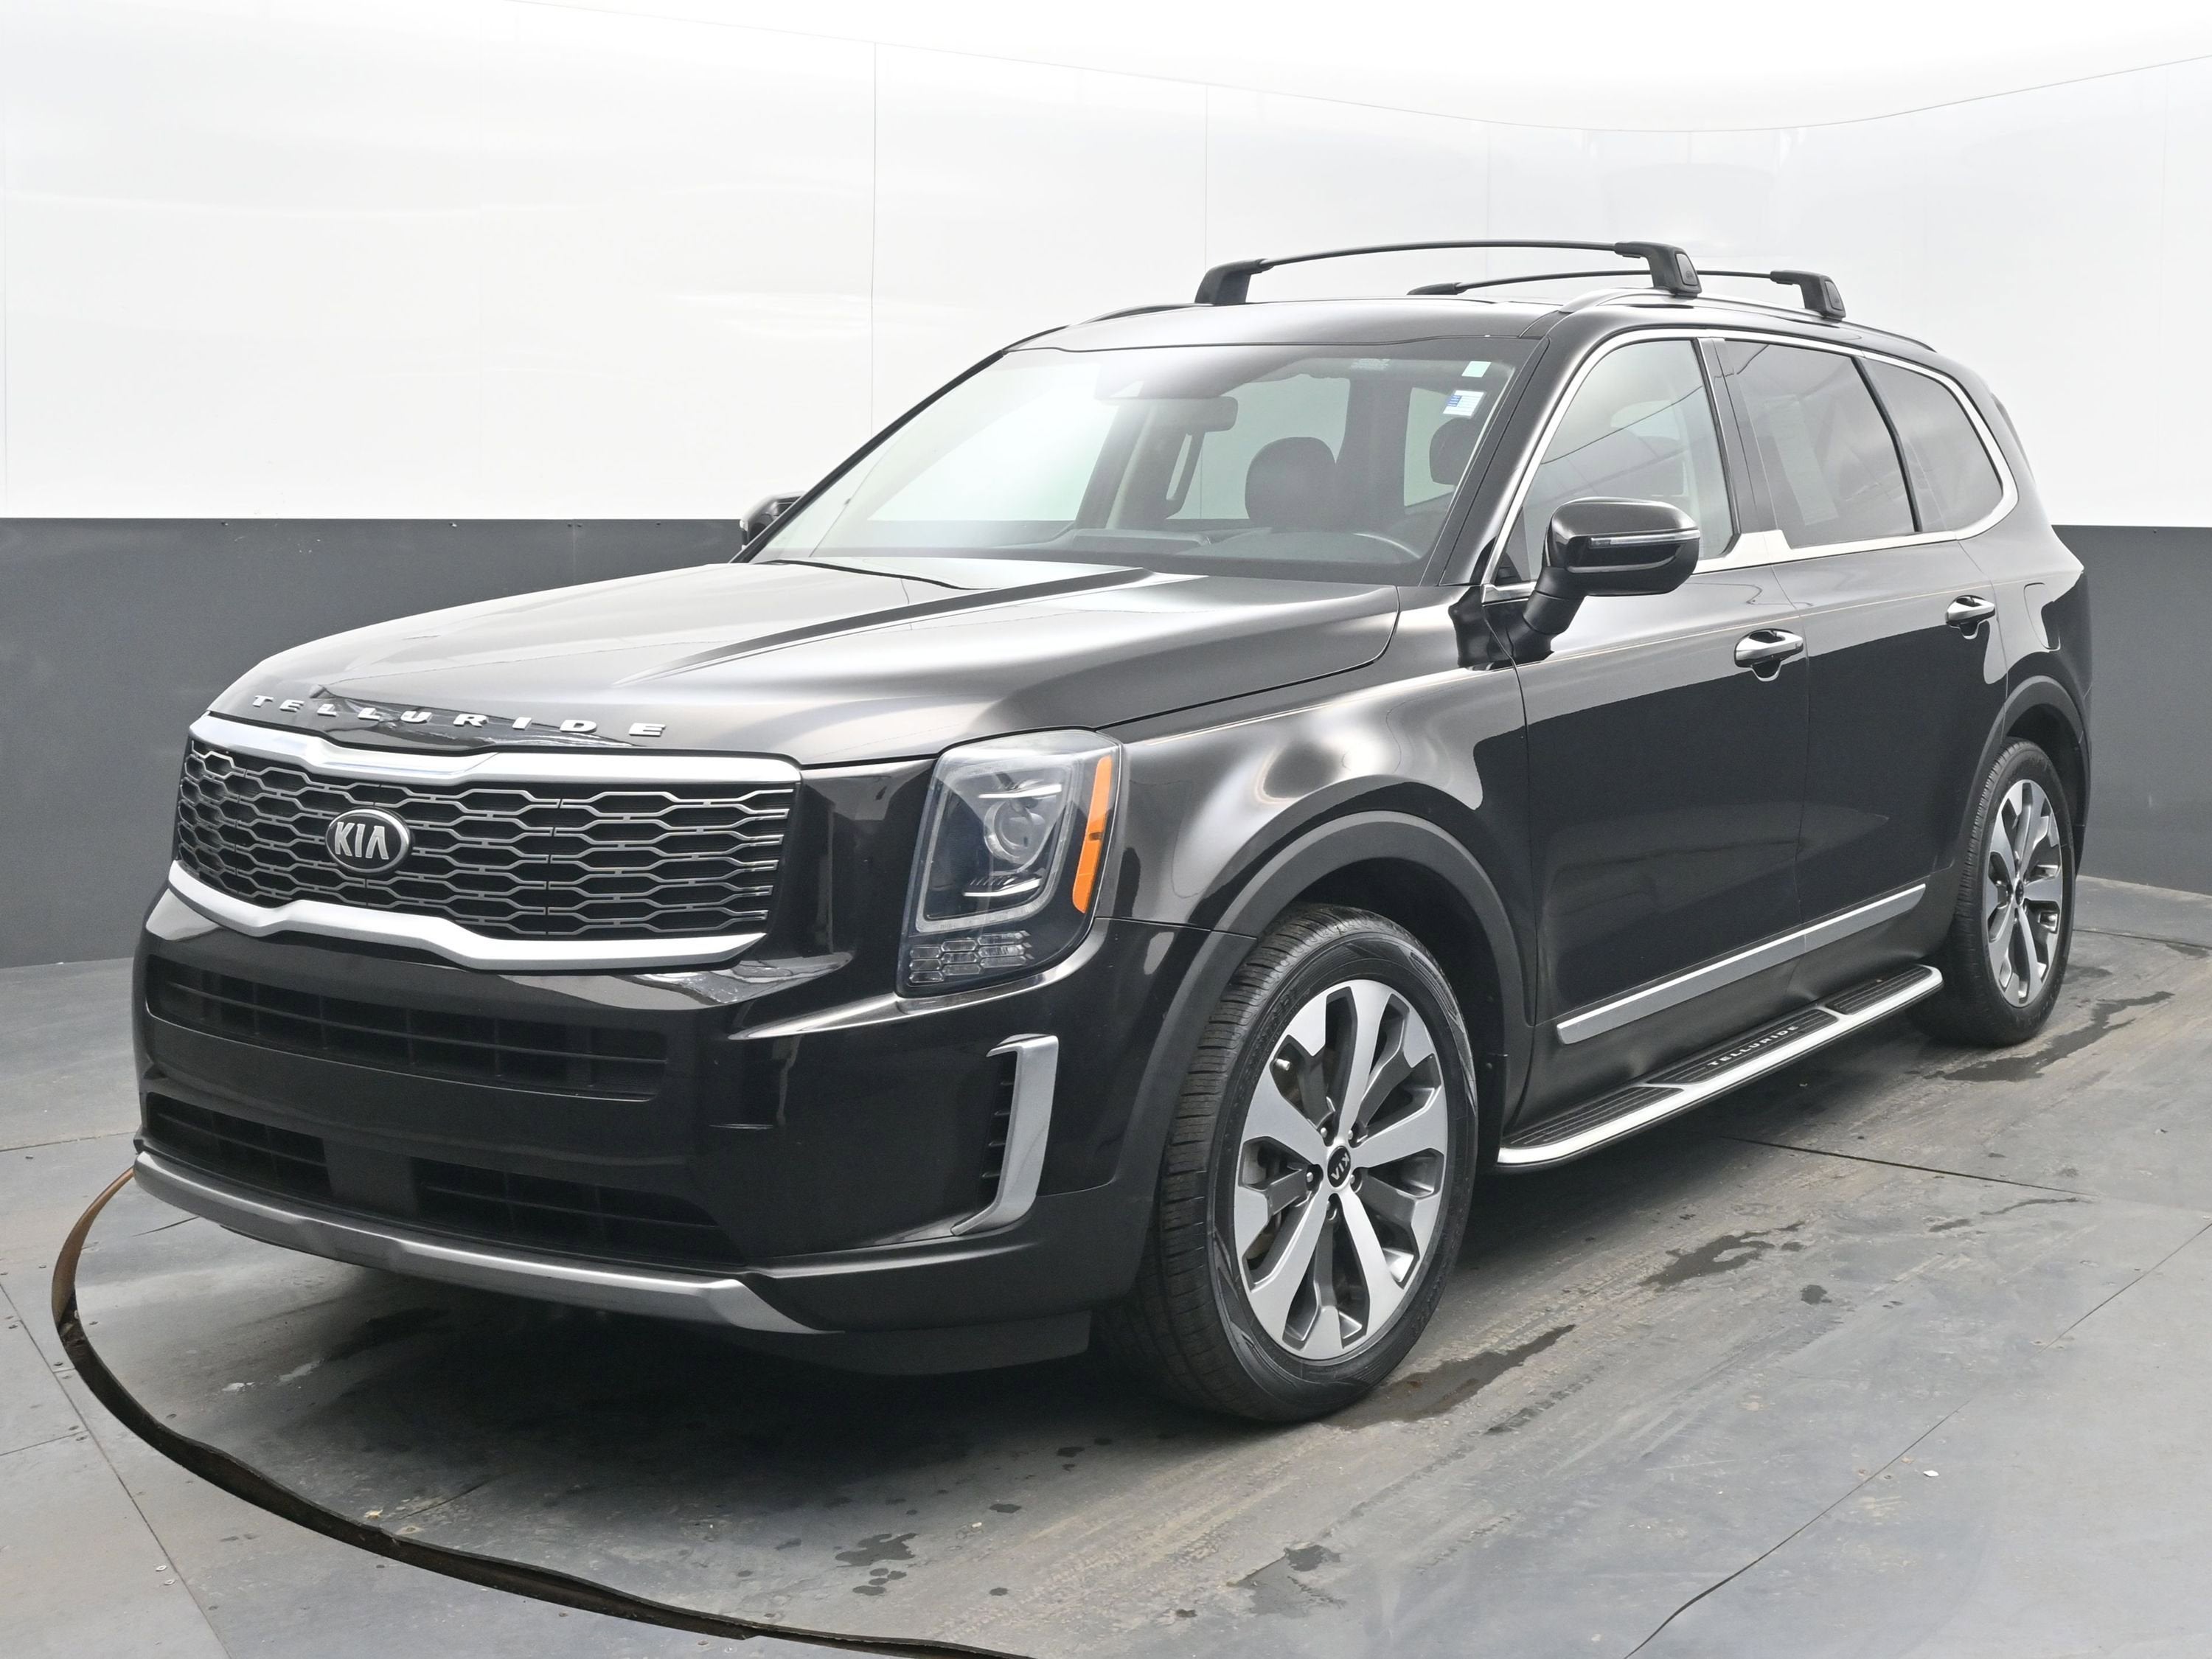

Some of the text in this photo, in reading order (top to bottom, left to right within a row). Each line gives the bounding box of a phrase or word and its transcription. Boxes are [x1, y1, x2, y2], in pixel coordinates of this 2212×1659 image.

[251, 695, 667, 737] TELLURIDE
[335, 821, 389, 860] KIA
[1707, 1026, 1799, 1065] TELLURIDE
[1331, 1152, 1350, 1180] KIA
